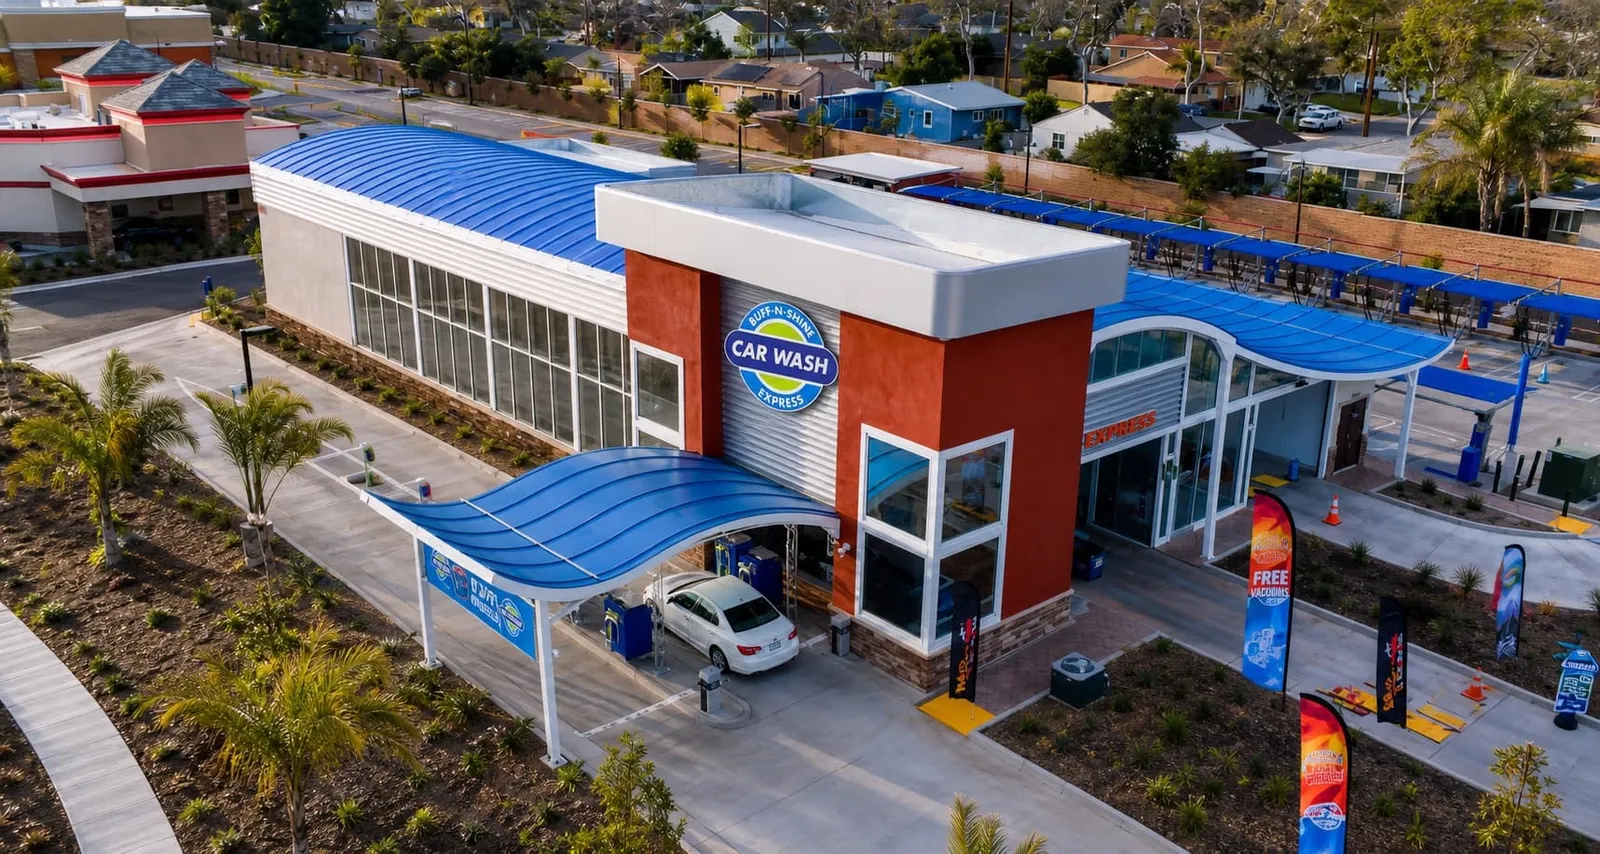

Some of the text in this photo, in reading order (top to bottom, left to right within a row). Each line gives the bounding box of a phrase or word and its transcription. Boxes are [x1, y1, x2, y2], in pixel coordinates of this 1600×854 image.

[748, 305, 815, 339] BUFF-N-SHINE
[731, 340, 829, 375] CAR WASH
[757, 387, 804, 408] EXPRESS
[1253, 569, 1289, 586] FREE
